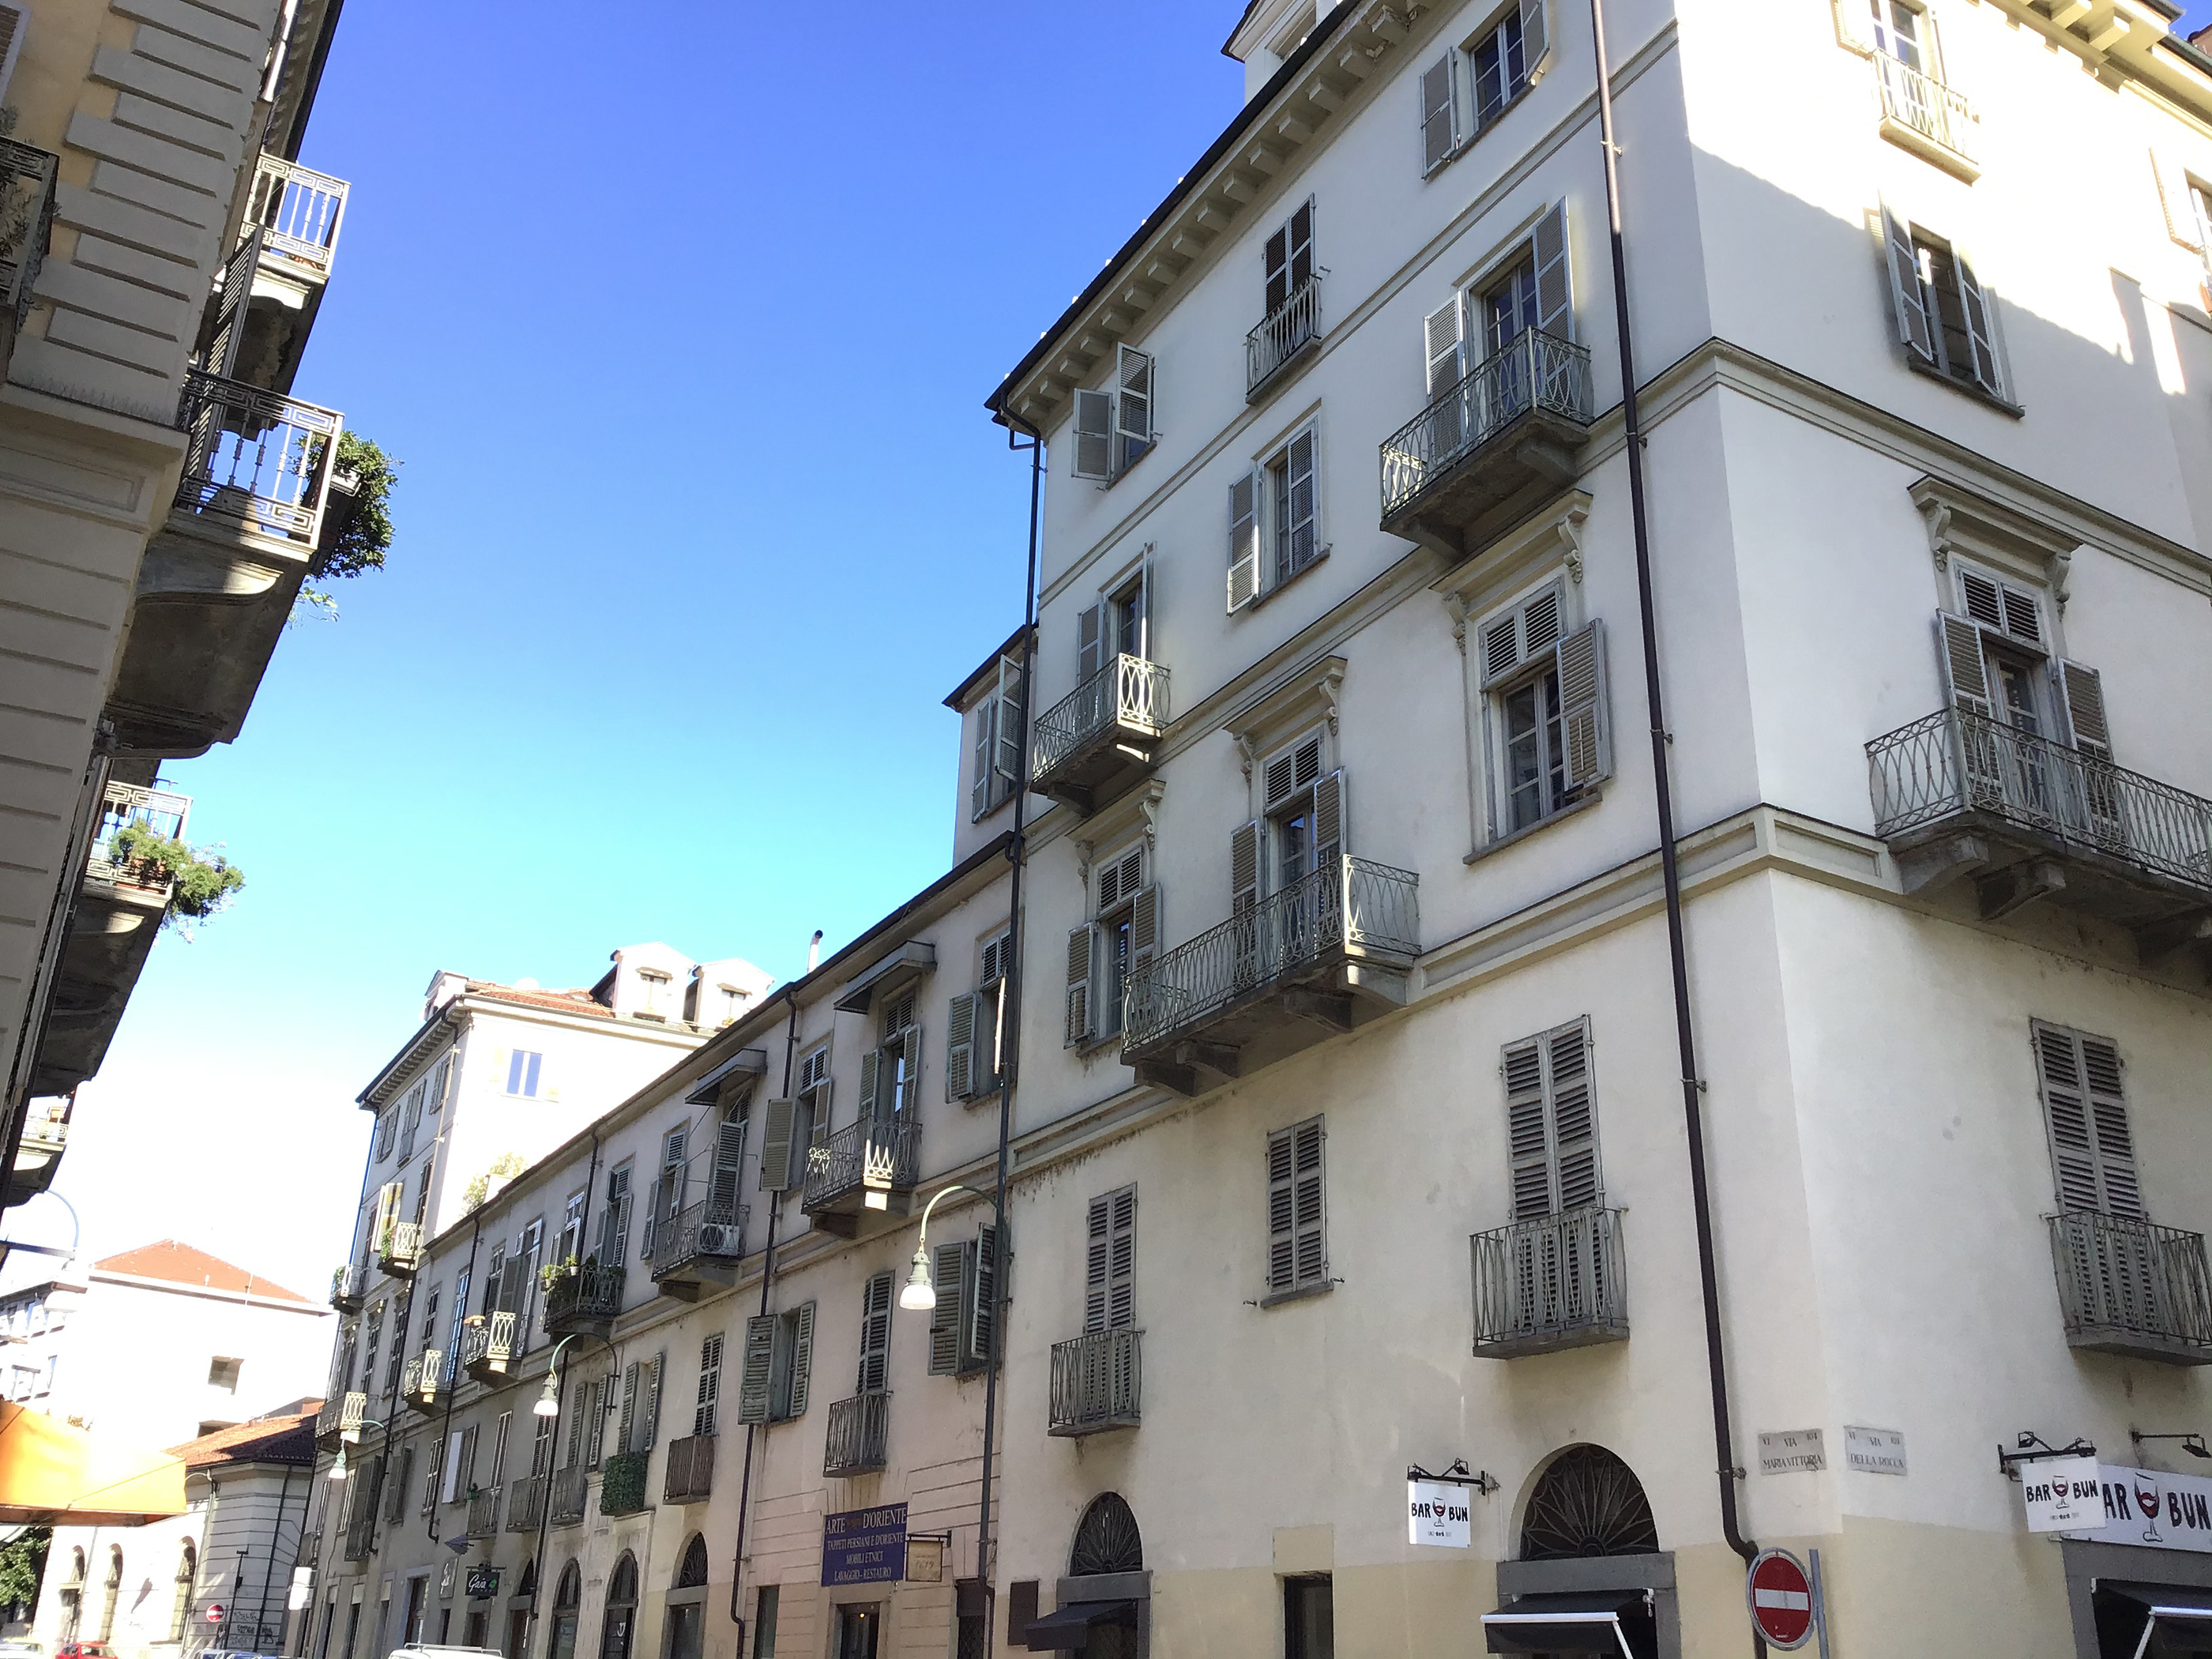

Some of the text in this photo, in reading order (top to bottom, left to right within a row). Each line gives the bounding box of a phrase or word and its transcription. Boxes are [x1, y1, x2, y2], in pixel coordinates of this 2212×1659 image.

[1783, 1437, 1797, 1447] VIA
[1869, 1436, 1882, 1447] VIA
[1762, 1454, 1823, 1469] MARIA VITTORIA
[1850, 1453, 1904, 1469] DELLA ROCCA
[2026, 1479, 2098, 1503] BAR BUN
[1411, 1502, 1469, 1522] BAR BUN
[2102, 1483, 2211, 1530] AR BUN
[826, 1507, 907, 1534] ARTE D'ORIENTE
[827, 1539, 847, 1551] TAPPETI
[847, 1537, 870, 1549] PERSIANI
[871, 1536, 875, 1546] E
[846, 1551, 884, 1565] MOBILI ETNICI
[834, 1569, 860, 1582] LAVAGGIO
[863, 1567, 892, 1579] RESTAURO
[468, 1574, 487, 1593] Gaia
